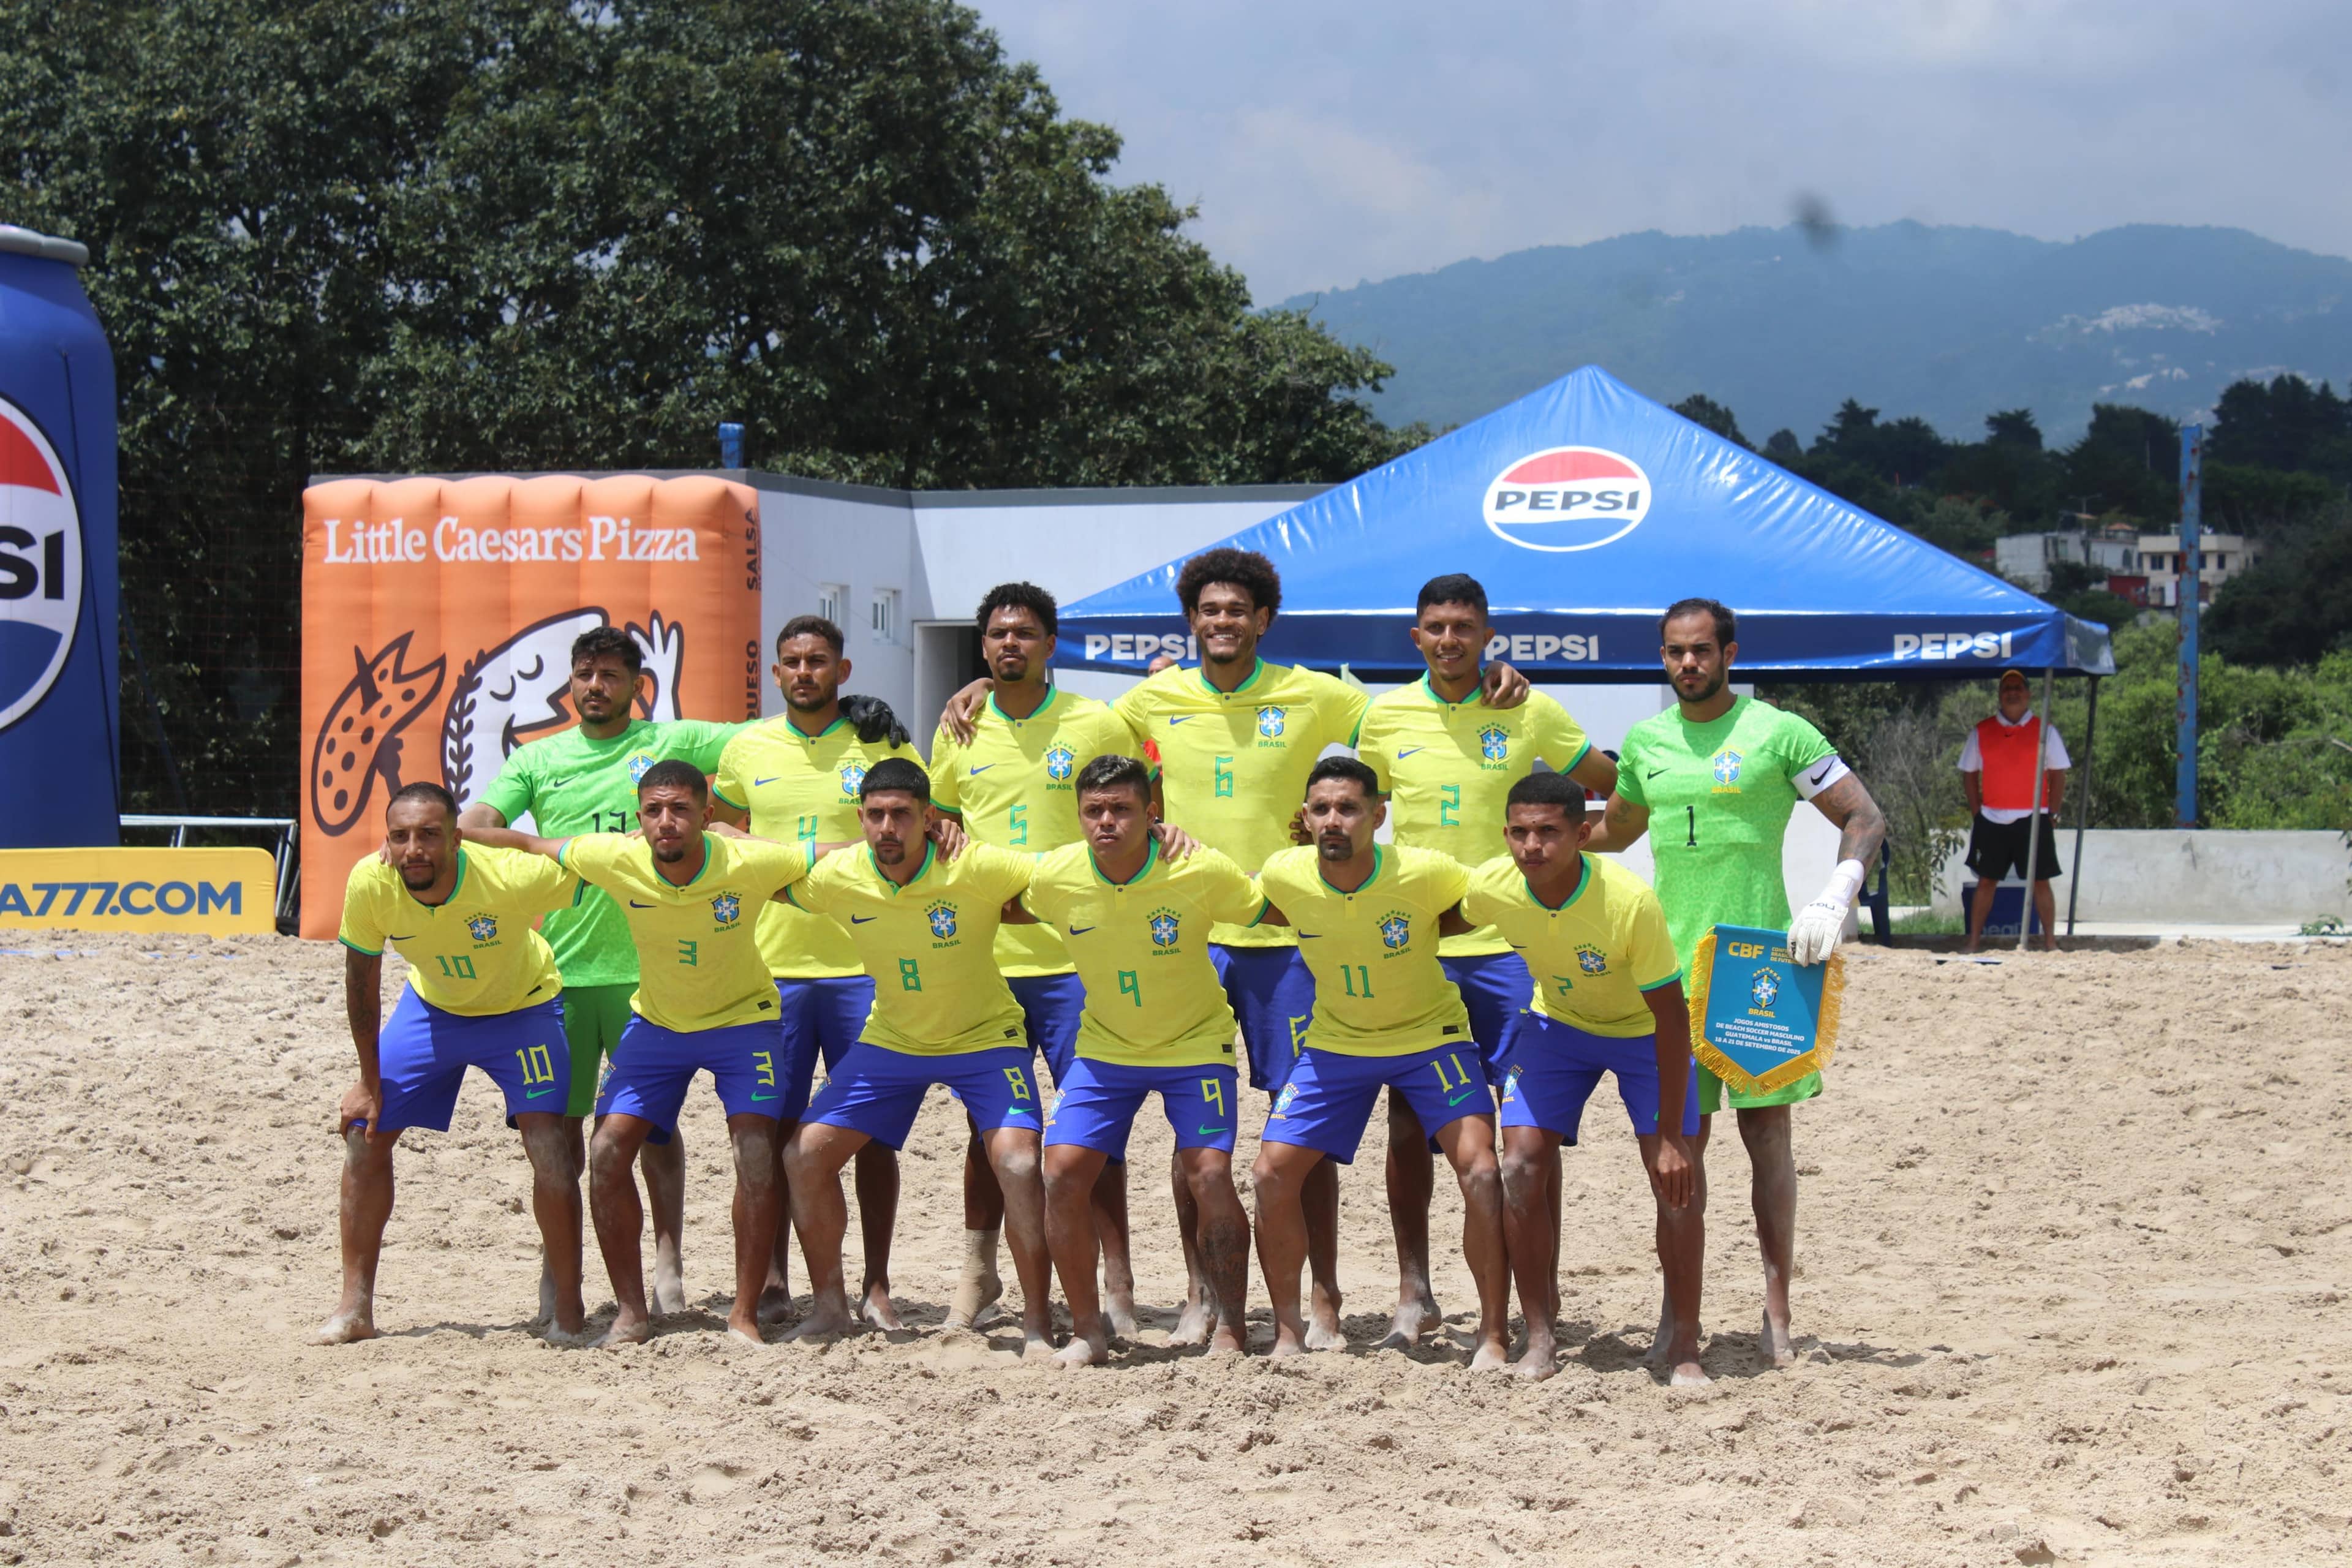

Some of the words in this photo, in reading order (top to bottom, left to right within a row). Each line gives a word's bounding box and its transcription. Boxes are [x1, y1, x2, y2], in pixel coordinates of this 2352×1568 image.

[1494, 490, 1640, 511] PEPSI
[324, 518, 426, 564] Little
[433, 516, 582, 562] Caesars
[589, 516, 700, 561] Pizza
[745, 510, 758, 590] SALSA
[1085, 634, 1197, 661] PEPSI
[1485, 635, 1599, 661] PEPSI
[1893, 631, 2013, 661] PEPSI
[1215, 756, 1233, 798] 6
[1441, 785, 1460, 827] 2
[798, 816, 818, 841] 4
[1009, 804, 1027, 845] 5
[1686, 805, 1697, 847] 1
[0, 881, 242, 916] A777.COM
[714, 922, 741, 933] BRASIL
[473, 940, 502, 949] BRASIL
[678, 939, 697, 967] 3
[932, 939, 961, 949] BRASIL
[1384, 947, 1411, 959] BRASIL
[1728, 942, 1764, 959] CBF
[435, 956, 476, 979] 10
[899, 958, 922, 992] 8
[1340, 964, 1374, 998] 11
[1118, 970, 1142, 1007] 9
[1552, 975, 1574, 997] 7
[1748, 1008, 1776, 1018] BRASIL
[1754, 1021, 1789, 1031] AMISTOSOS
[1725, 1031, 1762, 1042] GUATEMALA
[1744, 1041, 1776, 1051] SETEMBRO
[1746, 1026, 1769, 1035] SOCCER
[1770, 1030, 1804, 1041] MASCULINO
[516, 1044, 554, 1085] 10
[752, 1051, 774, 1087] 3
[1429, 1053, 1471, 1094] 11
[1003, 1066, 1031, 1101] 8
[1200, 1078, 1224, 1117] 9
